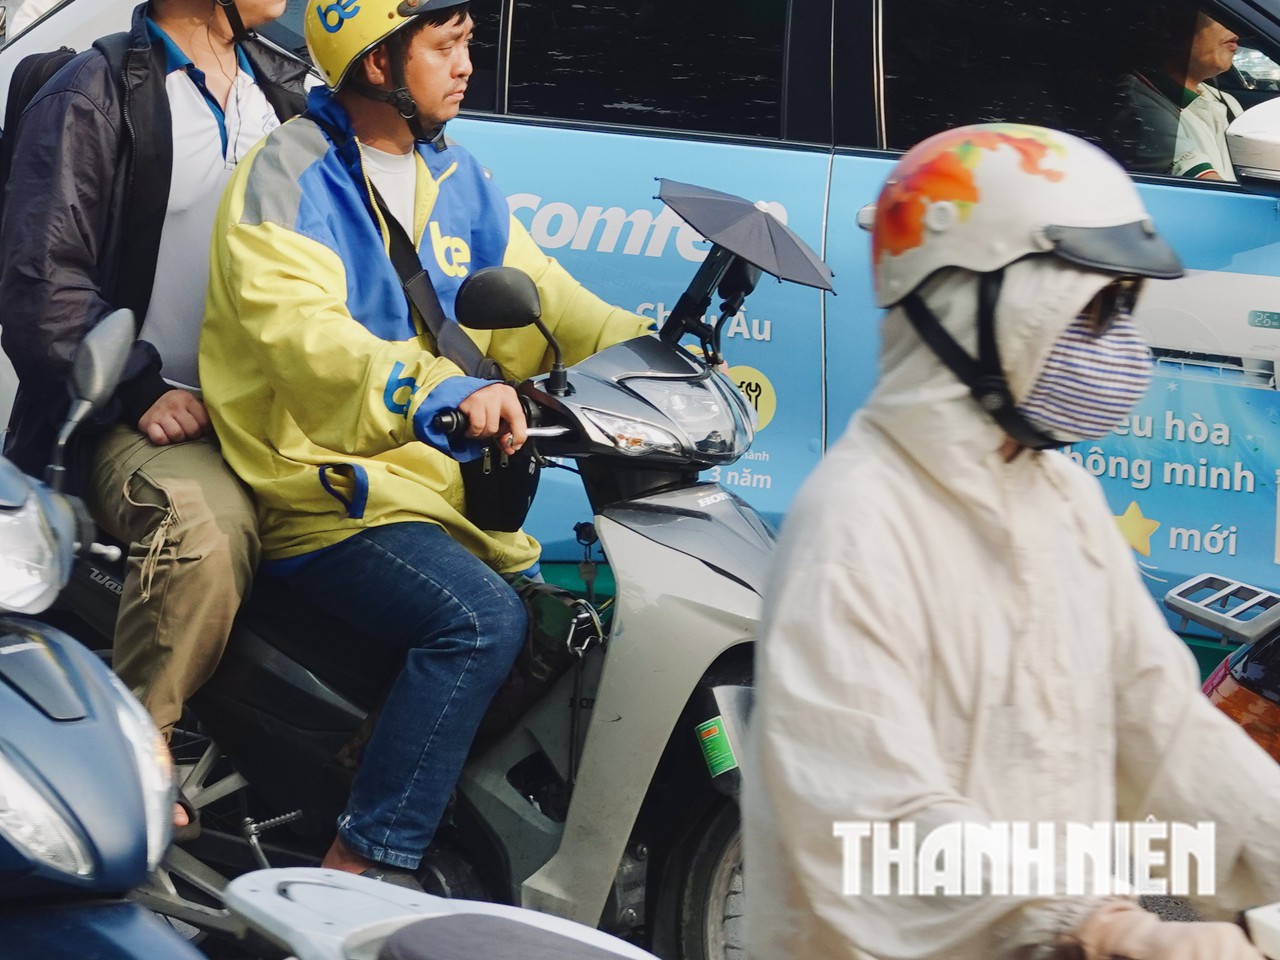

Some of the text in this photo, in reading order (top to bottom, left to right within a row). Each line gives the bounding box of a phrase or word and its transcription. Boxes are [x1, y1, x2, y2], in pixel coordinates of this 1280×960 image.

[429, 221, 471, 277] be
[727, 305, 772, 341] Âu
[1165, 410, 1231, 446] hòa
[710, 466, 772, 489] 3 năm
[1063, 446, 1255, 493] hông minh
[1168, 522, 1237, 555] mới
